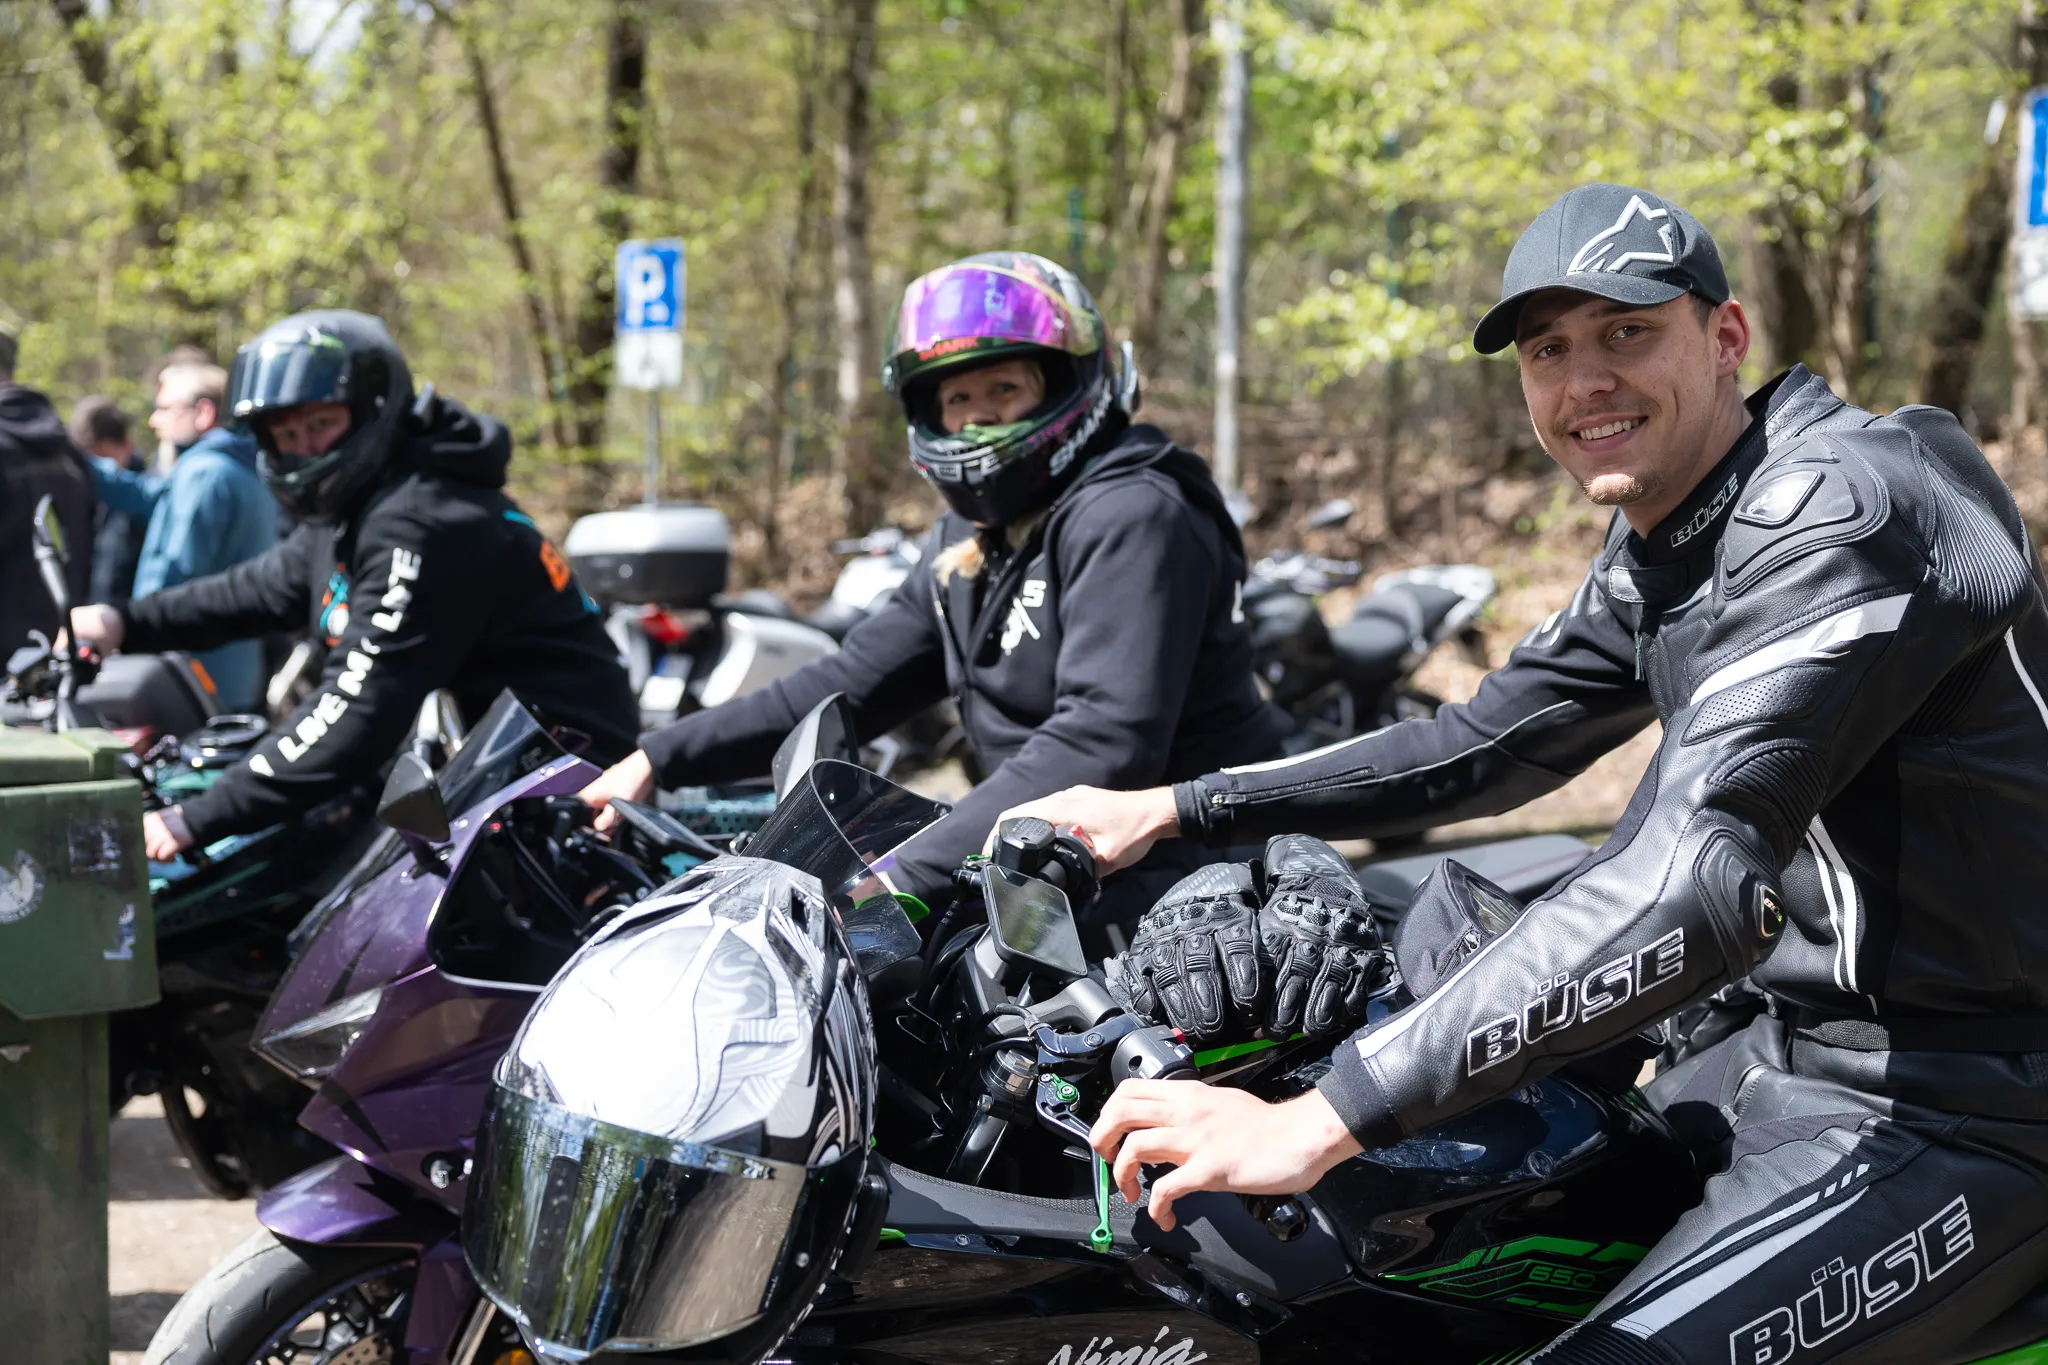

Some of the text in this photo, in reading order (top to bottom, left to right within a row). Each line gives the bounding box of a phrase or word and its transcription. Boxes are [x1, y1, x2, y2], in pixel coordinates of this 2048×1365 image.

[625, 255, 666, 325] P
[1670, 472, 1739, 548] BÜSE
[1467, 927, 1685, 1077] BÜSE
[1528, 1265, 1597, 1289] 650
[1729, 1193, 1975, 1365] BÜSE
